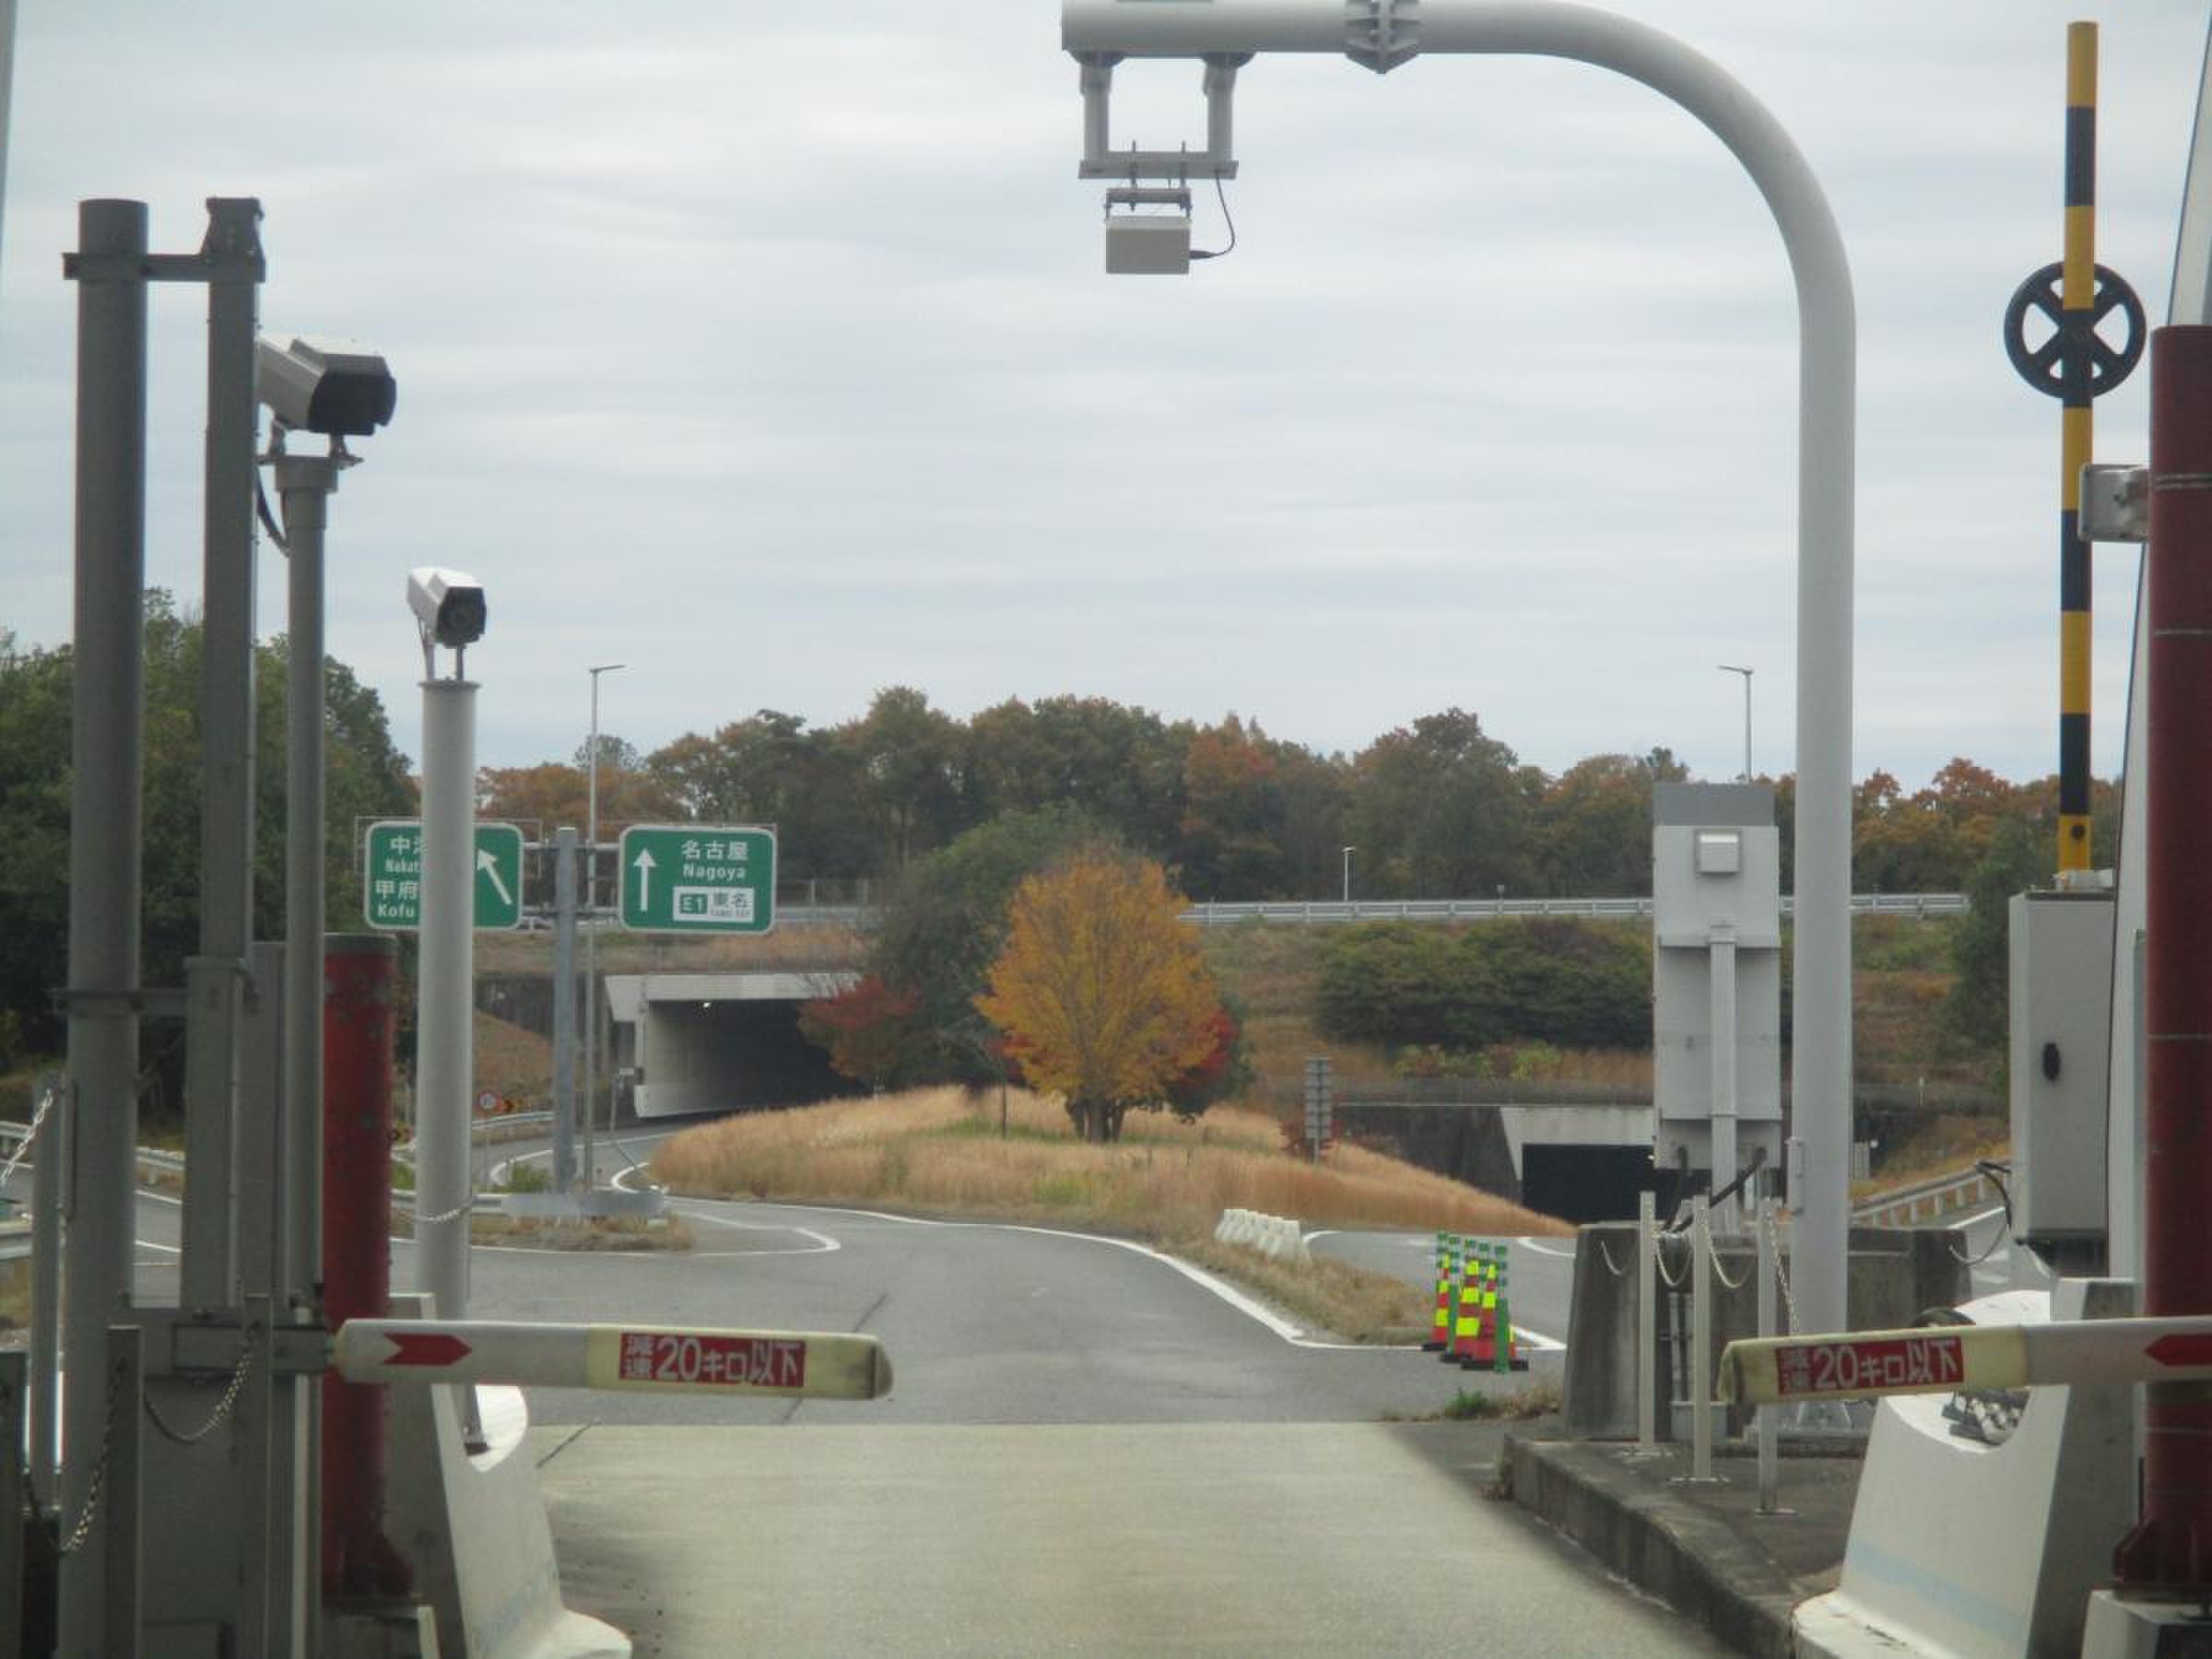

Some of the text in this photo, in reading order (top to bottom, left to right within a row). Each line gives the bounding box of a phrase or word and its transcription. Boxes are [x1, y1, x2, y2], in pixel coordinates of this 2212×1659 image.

[681, 840, 748, 861] 名古屋
[683, 864, 746, 882] Nagoya
[376, 880, 418, 900] 甲府
[378, 903, 415, 917] Kofu
[683, 897, 703, 912] E1
[656, 1335, 801, 1385] 20キロ以下
[1814, 1338, 1959, 1389] 20キロ以下
